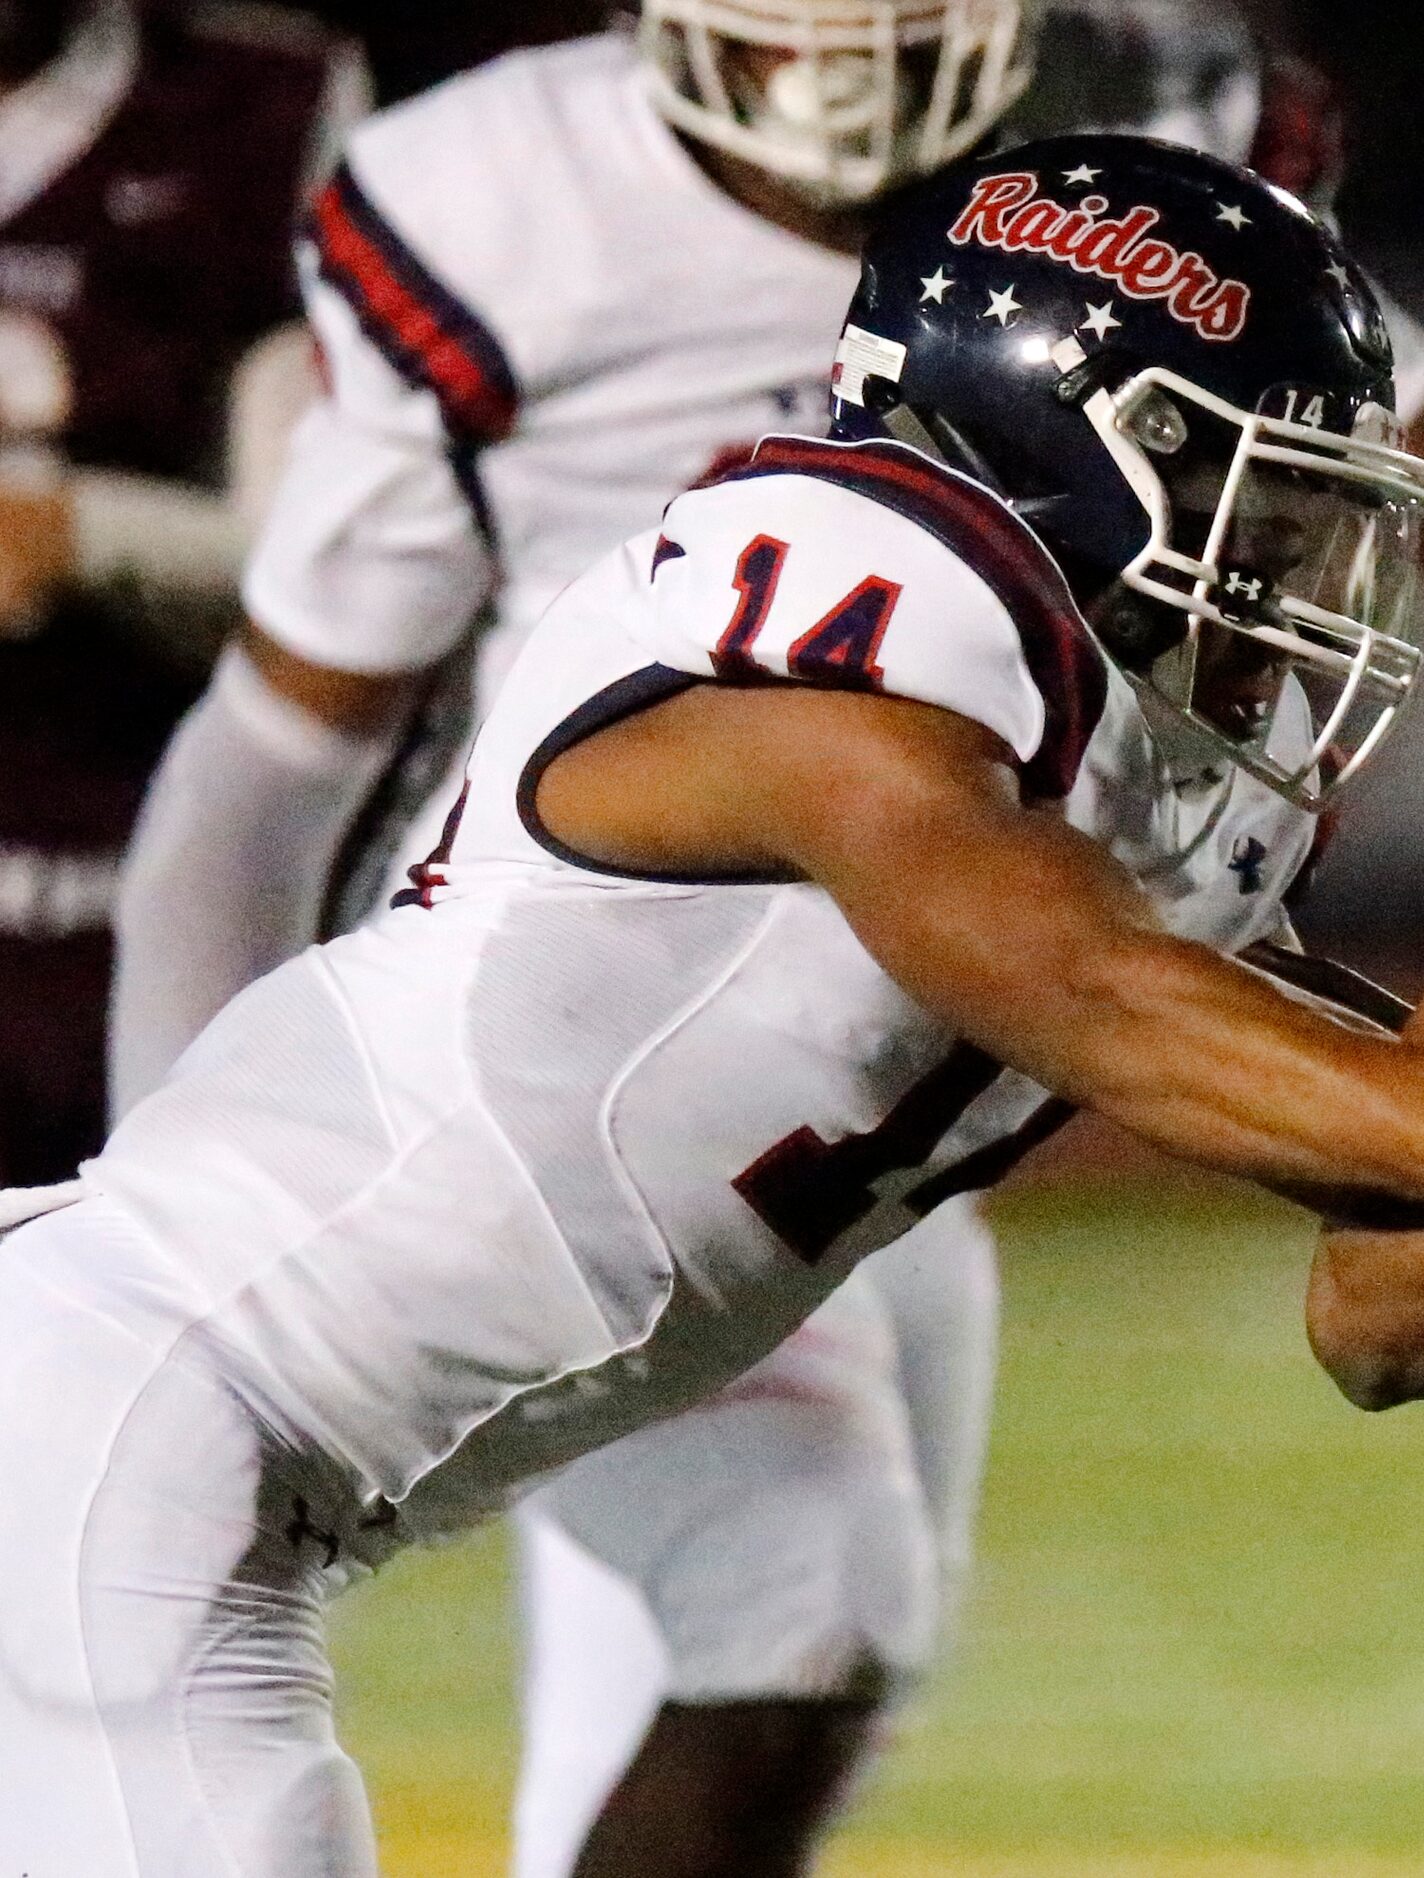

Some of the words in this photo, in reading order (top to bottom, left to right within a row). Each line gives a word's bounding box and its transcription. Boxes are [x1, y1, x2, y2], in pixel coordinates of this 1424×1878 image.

[947, 172, 1250, 342] Raiders
[1284, 389, 1324, 429] 14
[706, 533, 904, 692] 14
